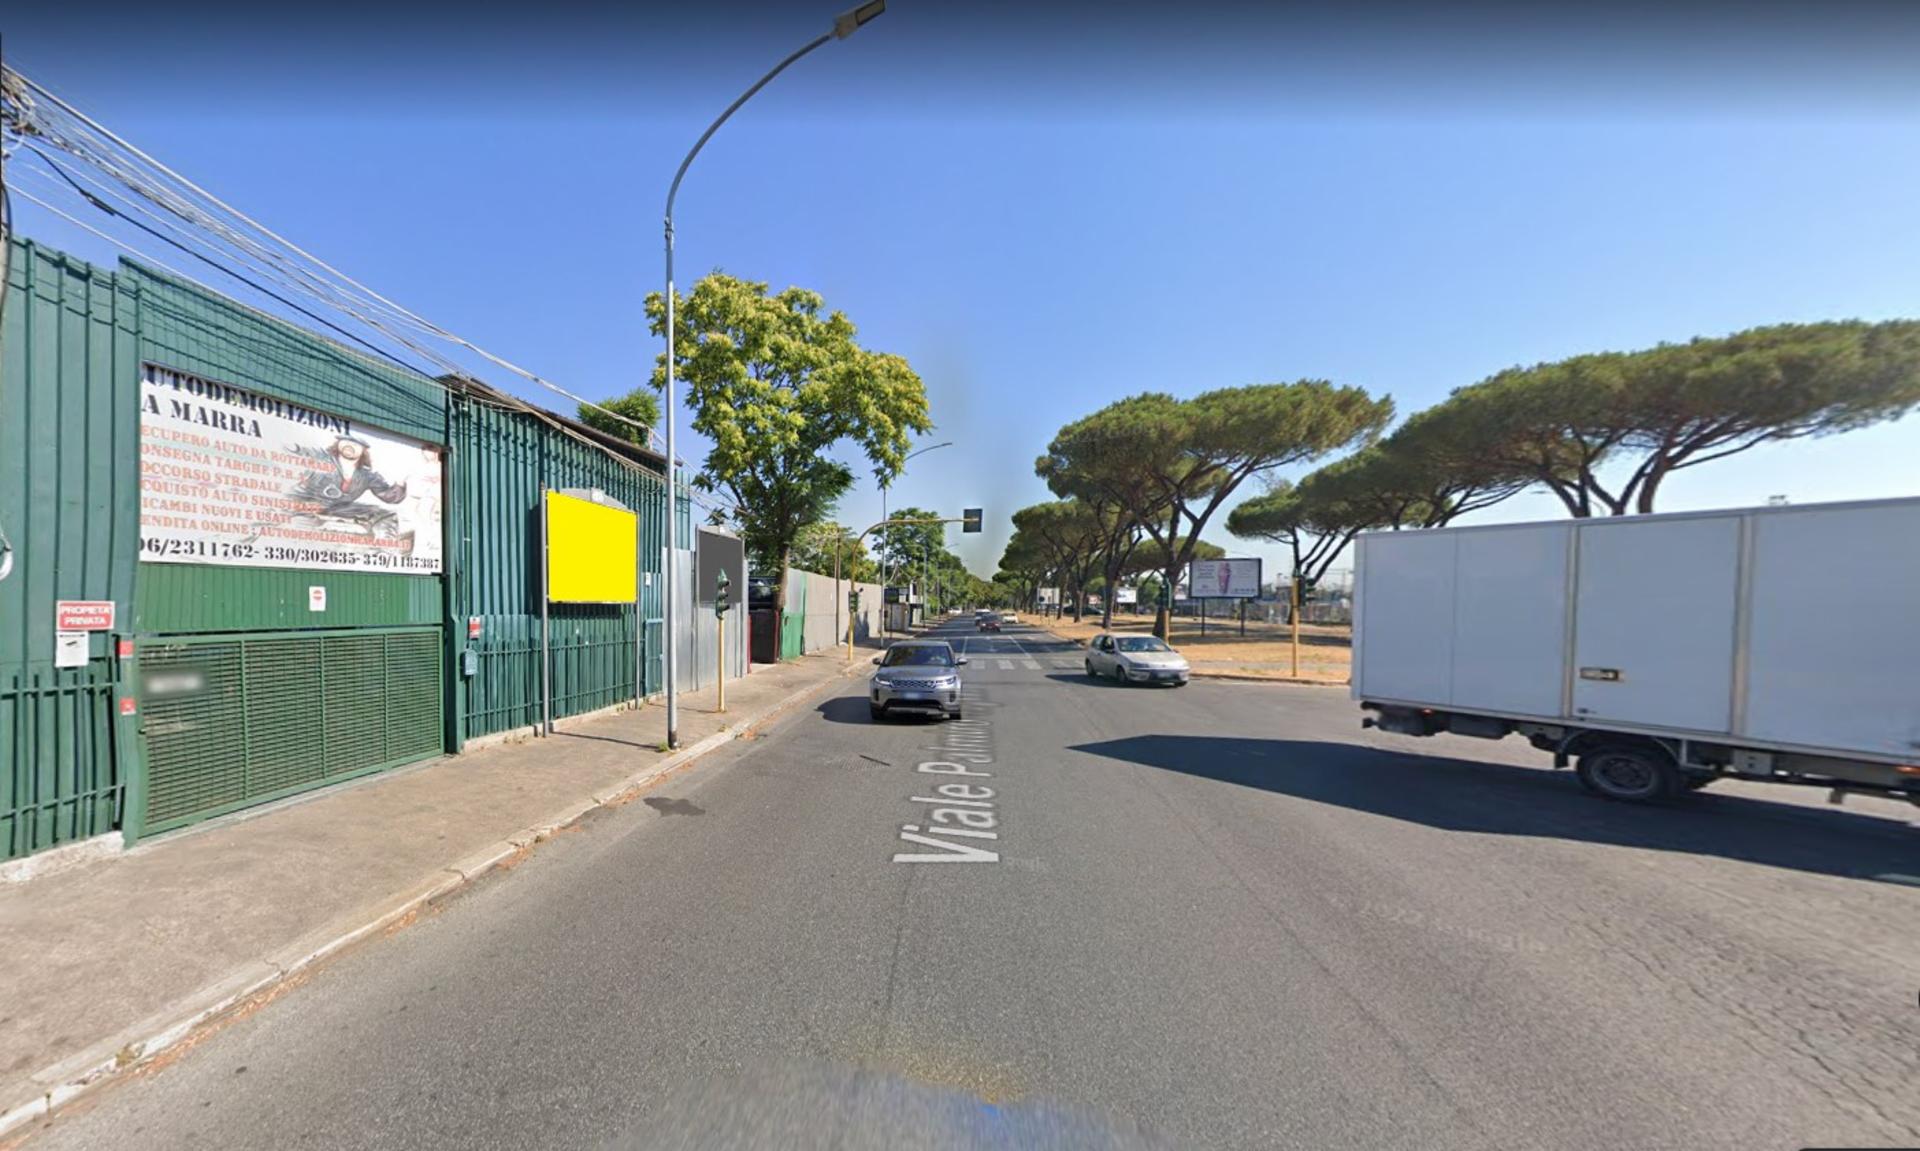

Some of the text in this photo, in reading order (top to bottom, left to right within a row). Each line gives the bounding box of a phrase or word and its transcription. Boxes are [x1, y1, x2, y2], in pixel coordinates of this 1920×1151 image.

[141, 394, 262, 438] A MARRA
[141, 424, 210, 447] ECUPERO
[214, 439, 248, 455] AUTO
[252, 447, 268, 460] DA
[214, 455, 270, 475] TARGHE
[214, 472, 282, 493] STRADALE
[213, 489, 248, 504] AUTO
[201, 503, 242, 519] NUOVI
[244, 510, 253, 520] E
[201, 520, 249, 535] ONLINE
[264, 546, 360, 563] 330/302635-
[363, 554, 440, 569] 379/1187387
